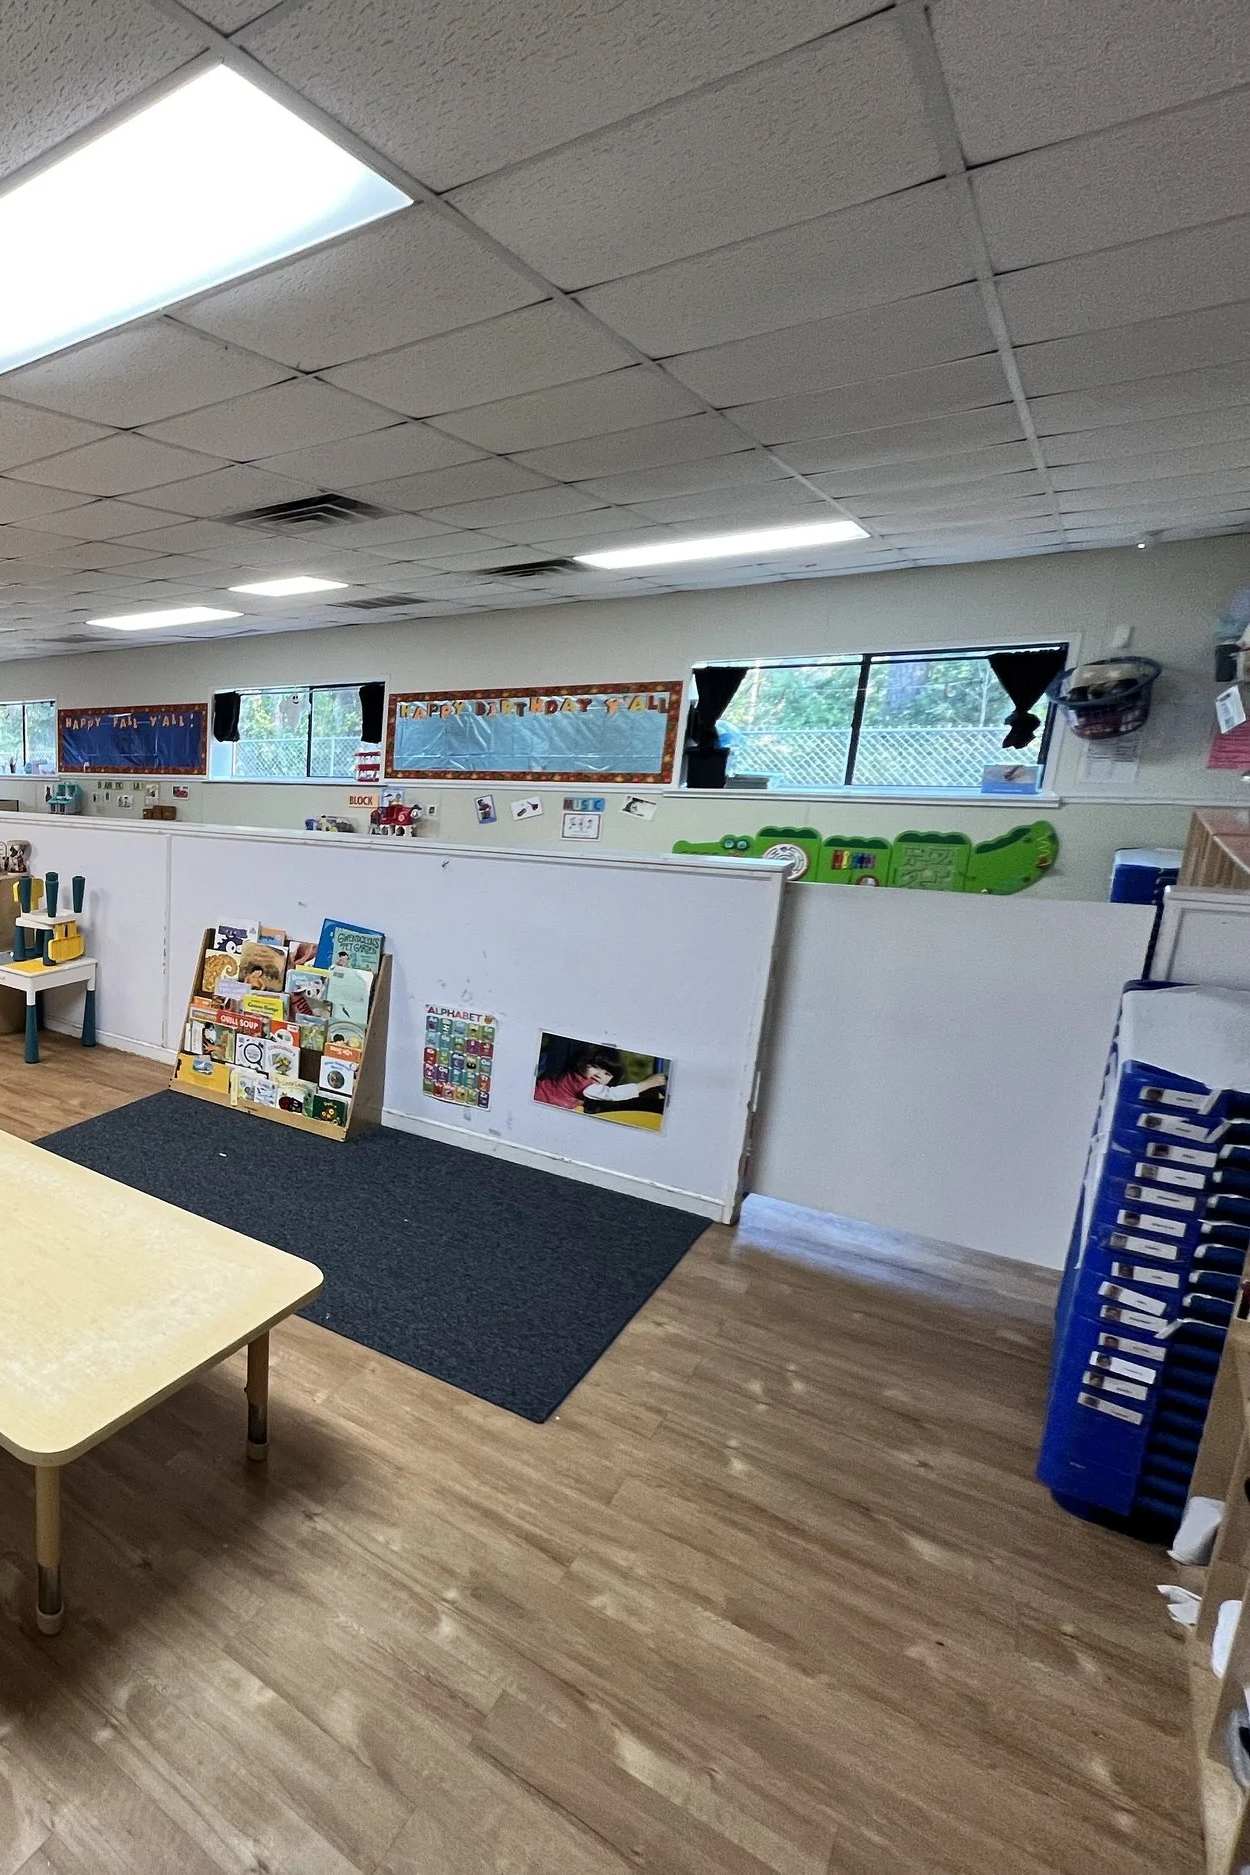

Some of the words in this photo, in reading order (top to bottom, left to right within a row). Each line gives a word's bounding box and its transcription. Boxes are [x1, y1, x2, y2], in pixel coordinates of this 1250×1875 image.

[400, 700, 465, 719] HAPPY
[475, 697, 592, 717] BIRTHDAY
[65, 717, 101, 730] HAPPY
[113, 717, 138, 729] FALL
[349, 796, 373, 806] BLOCK
[563, 799, 602, 810] MUSIC
[427, 1006, 482, 1022] ALPHABET
[220, 1014, 238, 1026] QUILL
[240, 1018, 259, 1030] SOUP
